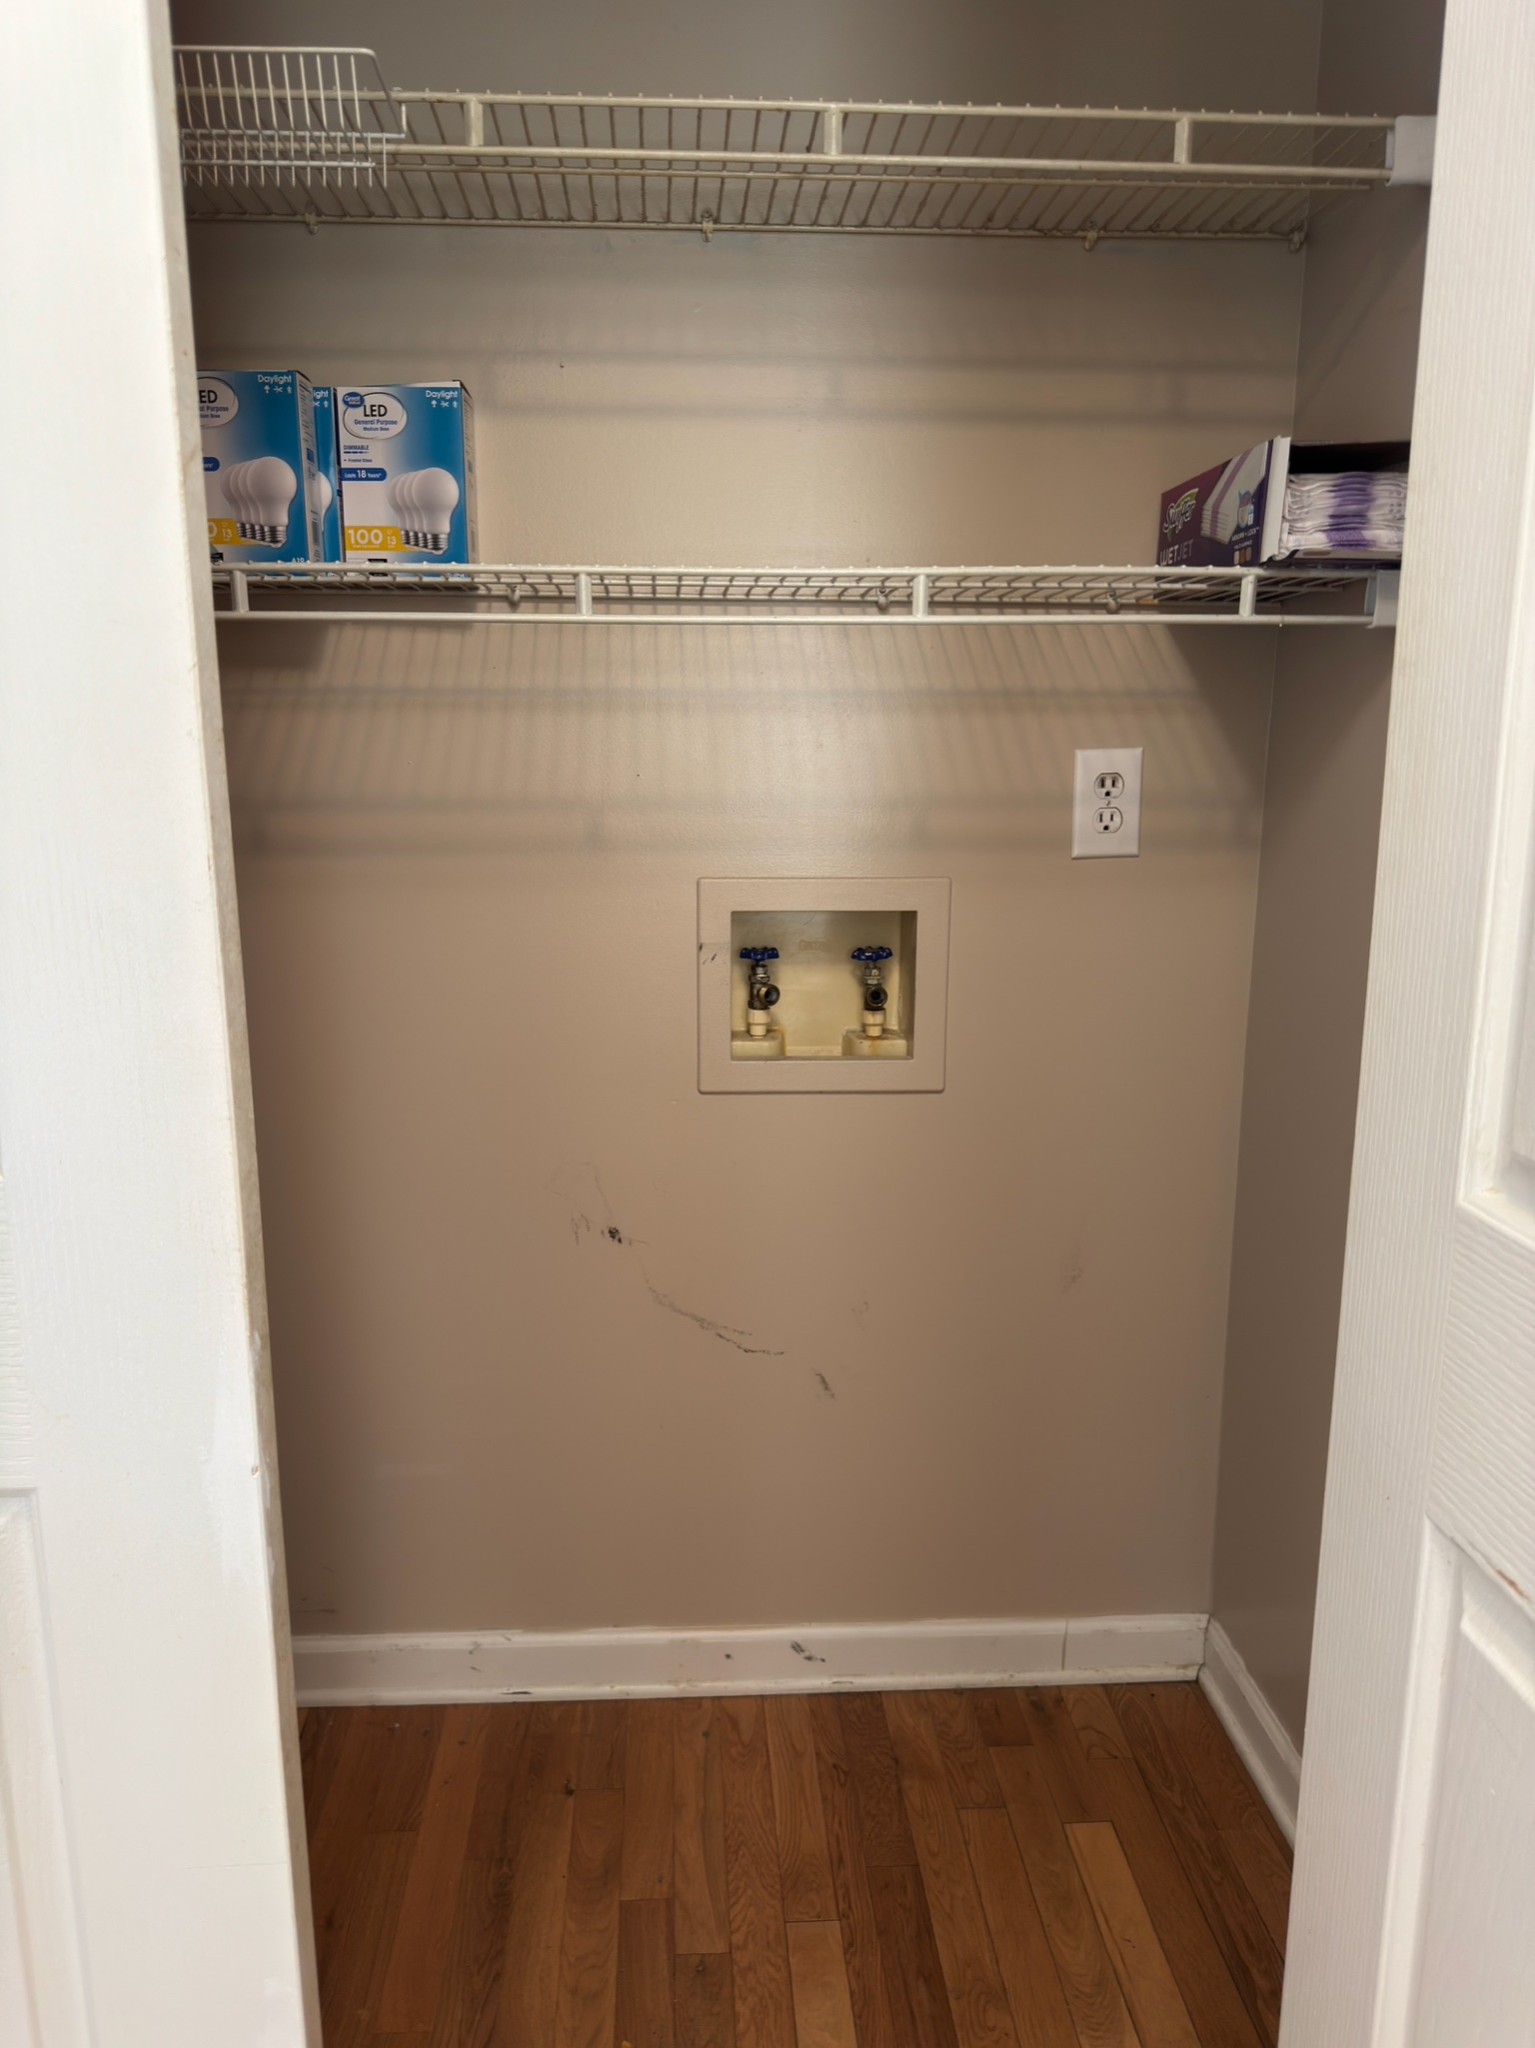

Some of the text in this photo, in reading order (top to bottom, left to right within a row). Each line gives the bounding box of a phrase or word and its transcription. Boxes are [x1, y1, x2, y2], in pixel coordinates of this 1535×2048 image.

[257, 374, 292, 385] Daylight
[199, 389, 218, 404] ED
[425, 390, 458, 400] Daylight
[363, 404, 388, 417] LED
[357, 470, 366, 479] 18
[222, 529, 232, 538] 13
[348, 529, 383, 545] 100
[387, 536, 397, 545] 13
